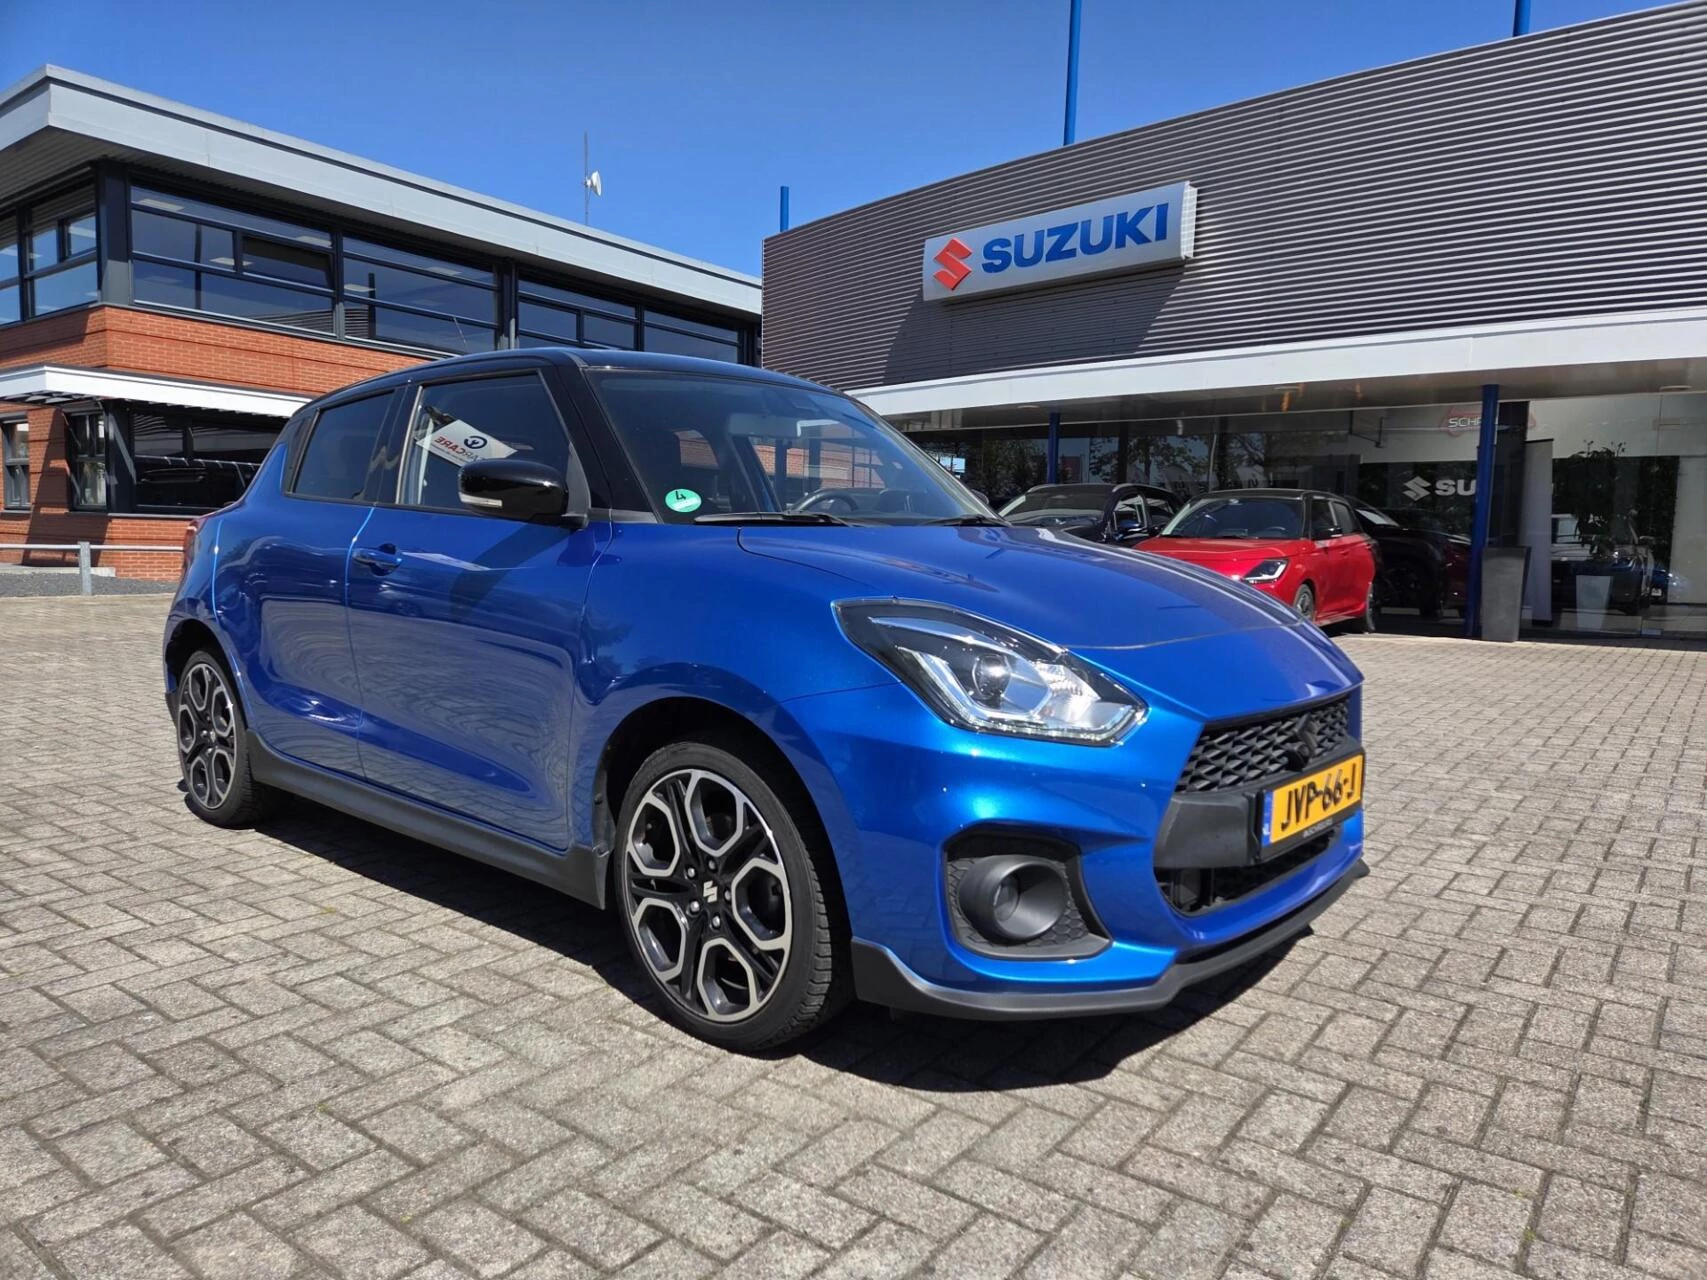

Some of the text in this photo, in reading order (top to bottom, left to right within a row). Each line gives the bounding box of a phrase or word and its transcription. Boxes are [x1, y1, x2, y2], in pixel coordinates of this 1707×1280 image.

[982, 202, 1169, 274] SUZUKI
[675, 490, 686, 500] 4
[1280, 763, 1357, 832] JVP-66-J
